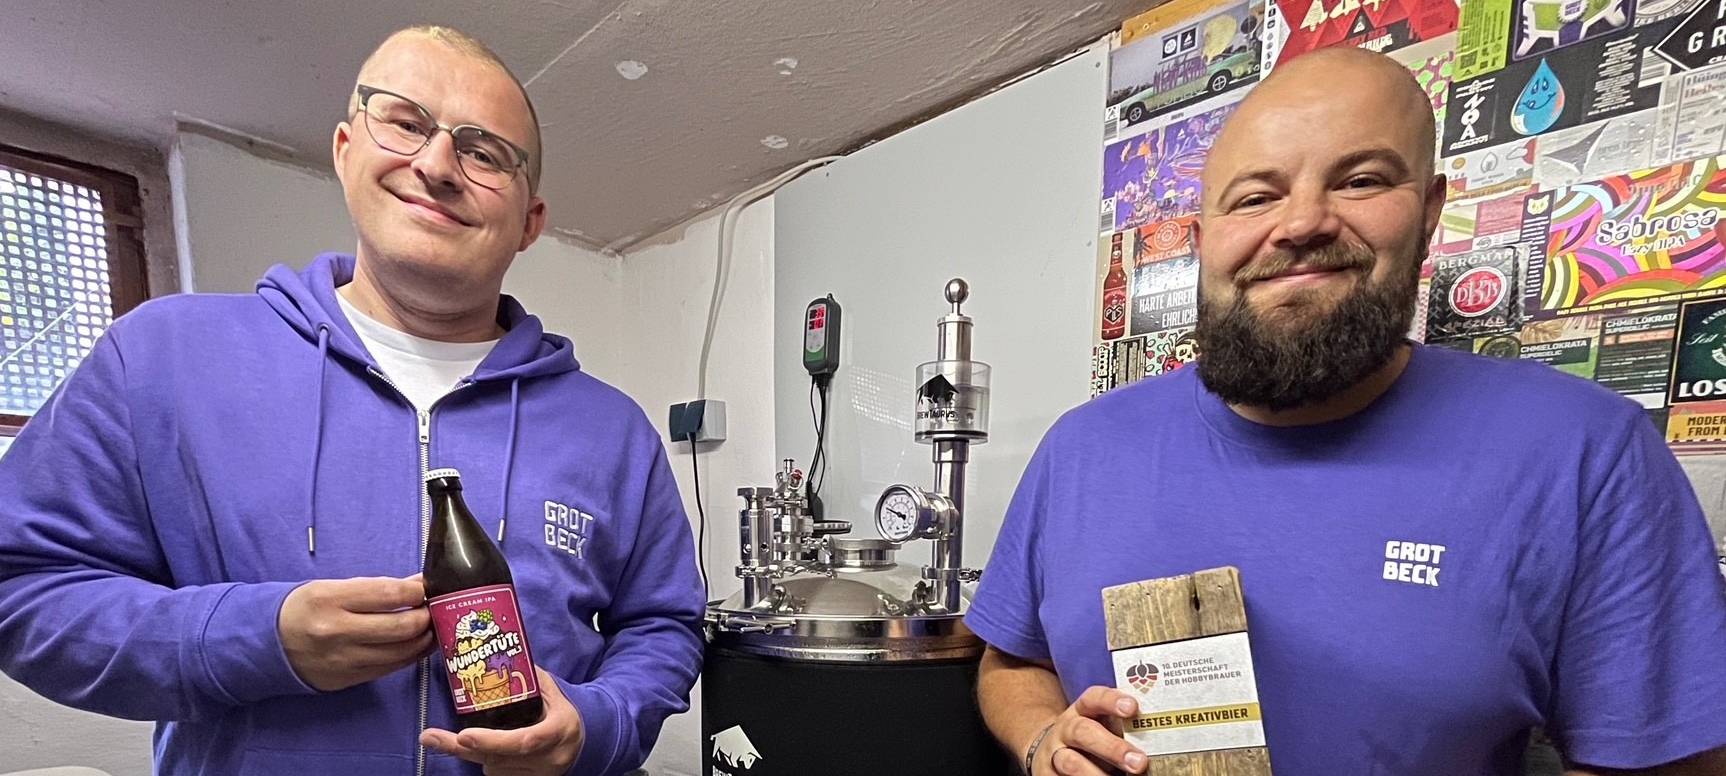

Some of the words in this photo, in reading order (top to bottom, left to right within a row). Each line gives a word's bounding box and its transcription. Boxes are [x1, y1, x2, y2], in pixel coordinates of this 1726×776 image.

[1598, 208, 1718, 243] Sabrosa
[1139, 293, 1165, 313] HARTE
[1520, 340, 1587, 353] CHMIELOKRATA
[1688, 426, 1720, 436] FROM
[544, 500, 594, 533] GROT
[544, 523, 586, 559] BECK
[1385, 540, 1446, 564] GROT
[1382, 561, 1440, 587] BECK
[446, 603, 457, 611] ICE
[458, 599, 483, 608] CREAM
[446, 632, 520, 674] WUNDERTÜTE
[1173, 657, 1215, 668] DEUTSCHE
[1163, 663, 1229, 678] MEISTERSCHAFT
[1164, 678, 1181, 686] DER
[1181, 671, 1242, 684] HOBBYBRAUER
[1132, 716, 1173, 729] BESTES
[1175, 708, 1249, 725] KREATIVBIER
